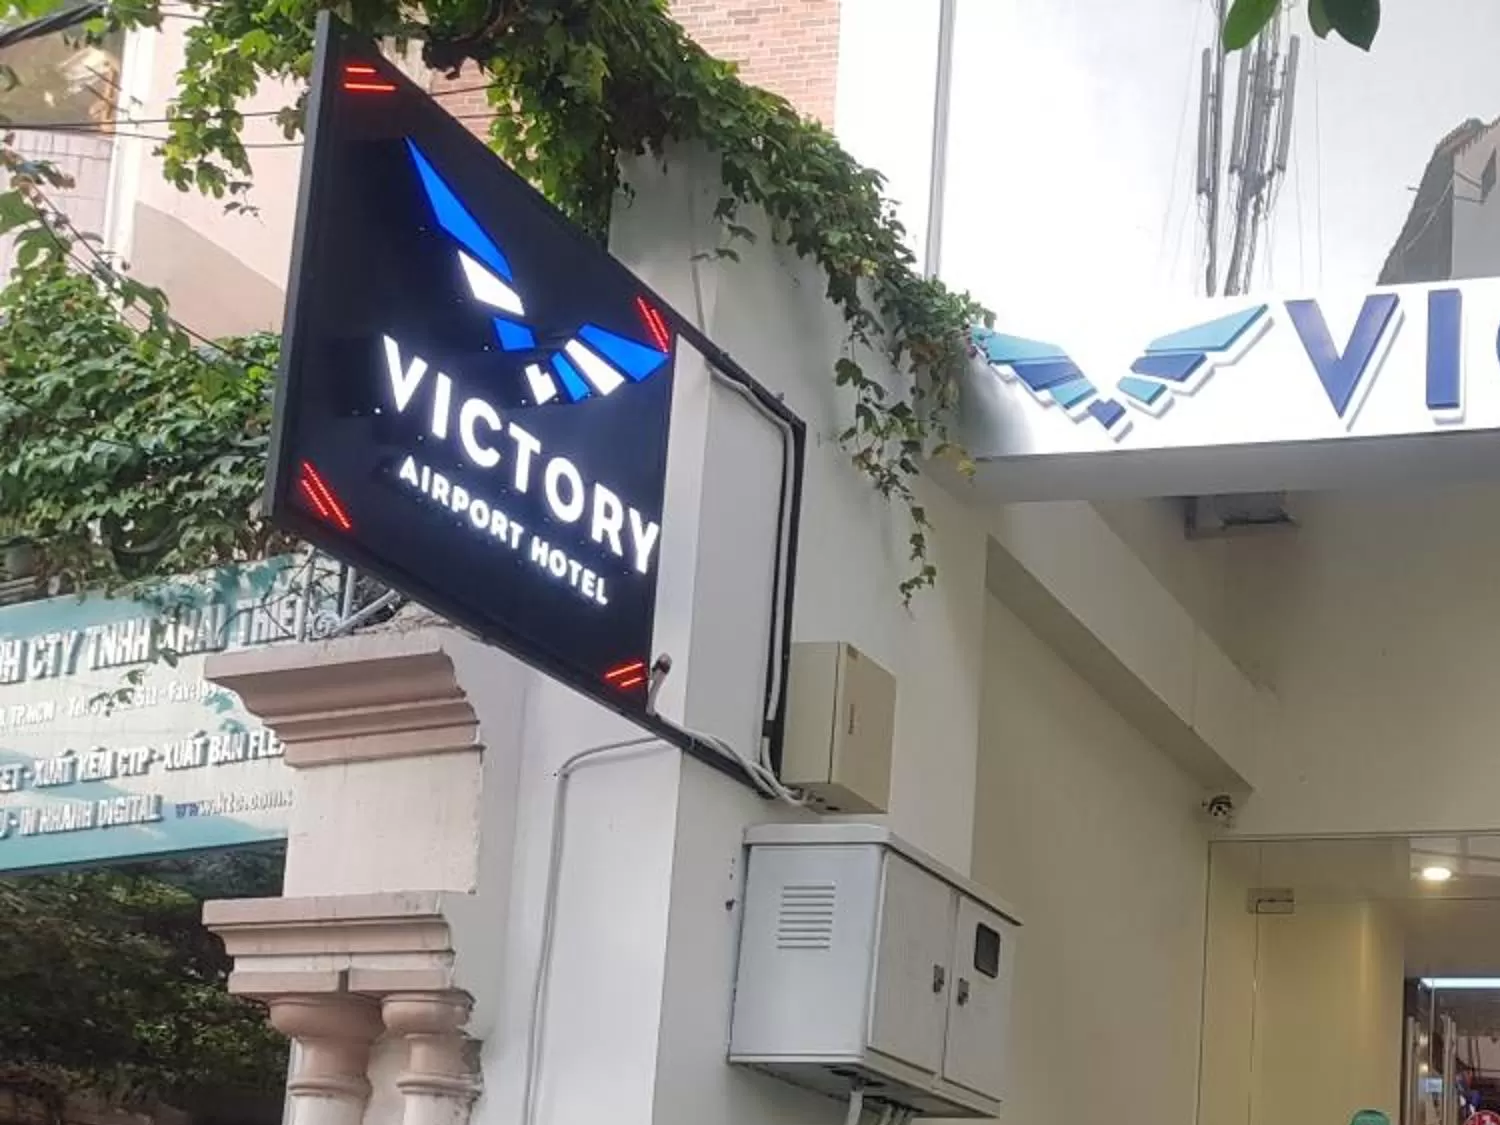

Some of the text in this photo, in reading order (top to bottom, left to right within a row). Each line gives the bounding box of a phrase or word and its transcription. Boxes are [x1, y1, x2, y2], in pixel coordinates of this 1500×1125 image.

[383, 335, 659, 574] VICTORY
[400, 456, 608, 605] AIRPORT HOTEL
[86, 617, 150, 671] TNHH
